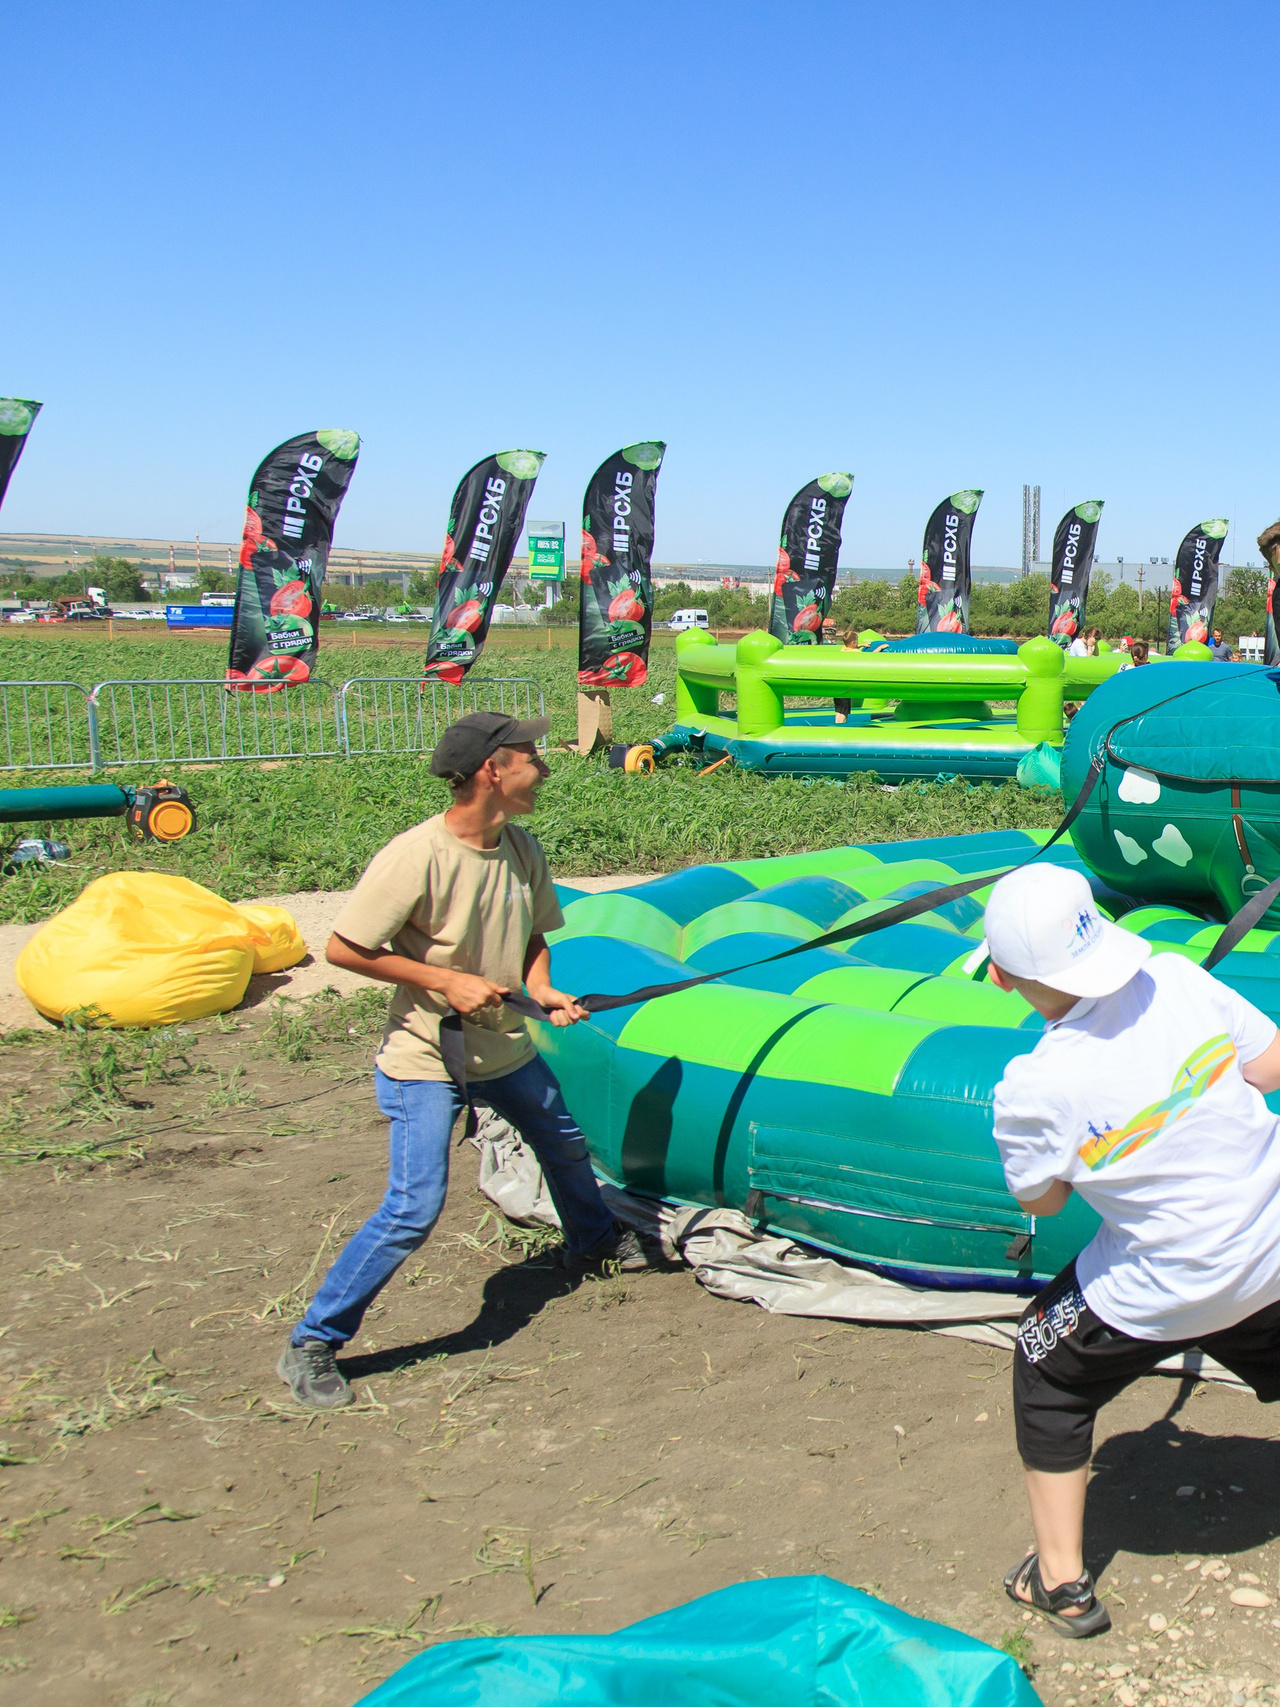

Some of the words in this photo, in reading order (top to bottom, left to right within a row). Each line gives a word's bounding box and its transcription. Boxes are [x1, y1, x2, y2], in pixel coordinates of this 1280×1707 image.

[286, 452, 324, 514] РСХБ
[613, 471, 633, 531] РСХБ
[475, 476, 506, 540] РСХБ
[807, 498, 827, 551] РСХБ
[943, 514, 960, 564] РСХБ
[1063, 523, 1082, 568] РСХБ
[1192, 539, 1207, 584] РСХБ
[271, 631, 300, 641] Бабки
[280, 637, 313, 649] грядки
[611, 632, 634, 642] Бабки
[618, 635, 644, 647] грядки
